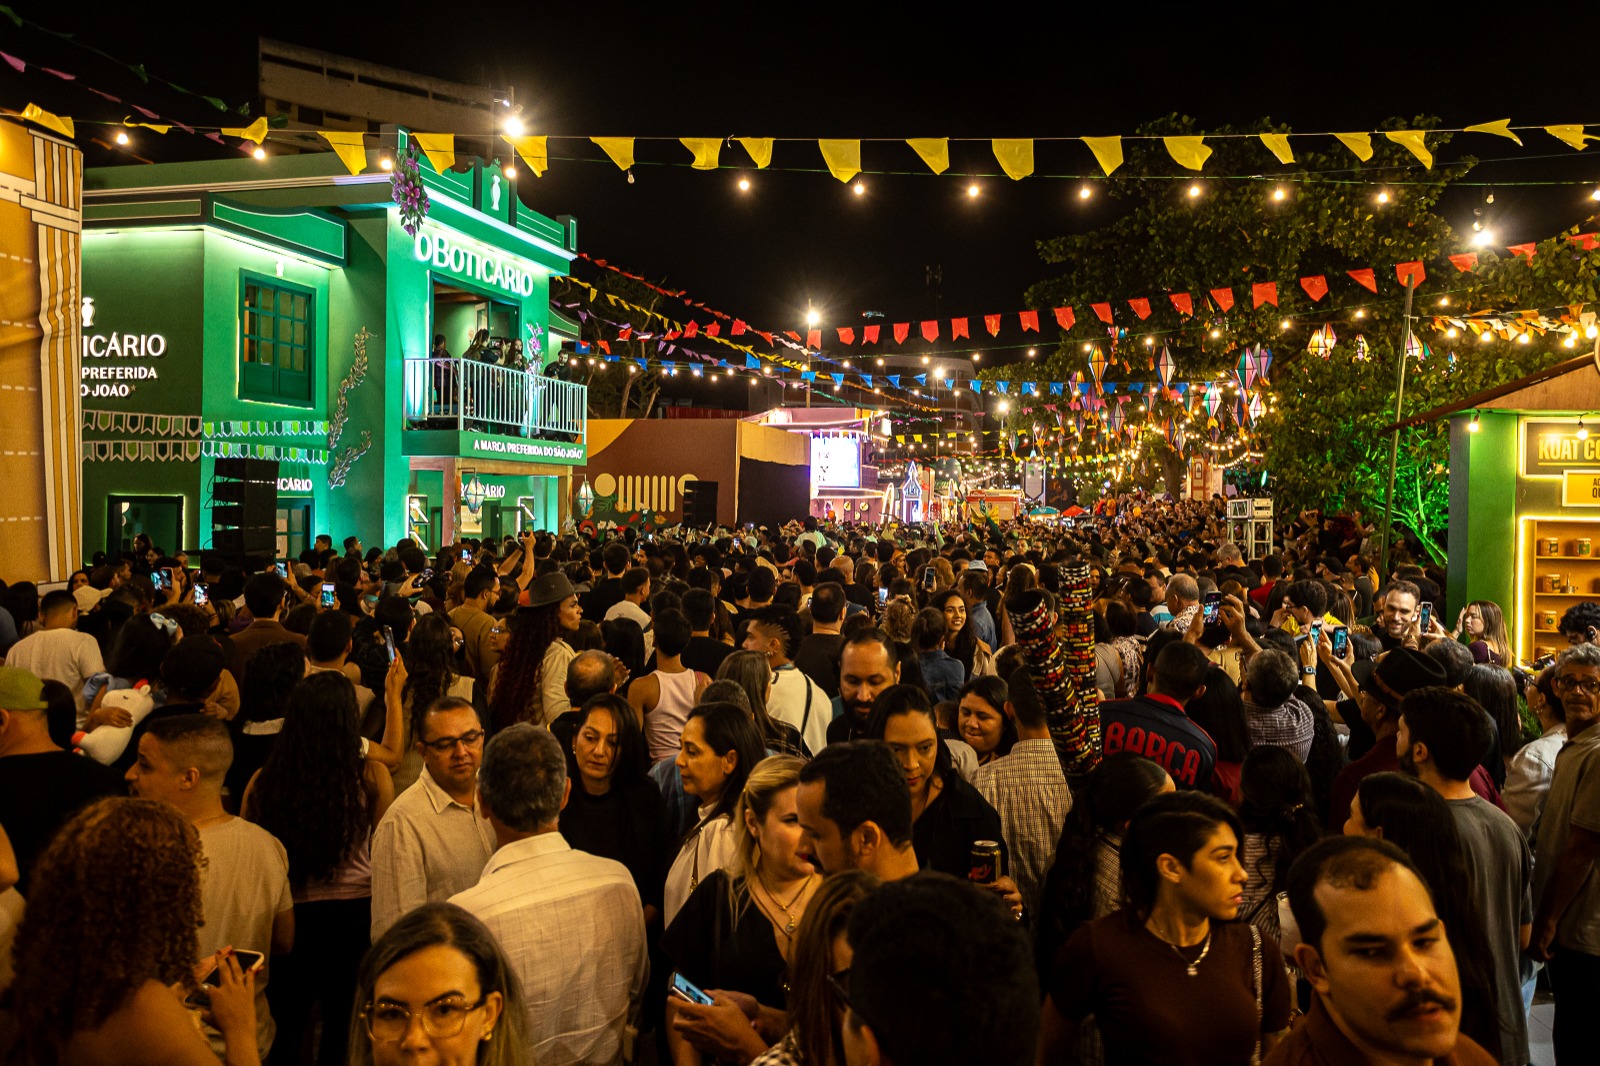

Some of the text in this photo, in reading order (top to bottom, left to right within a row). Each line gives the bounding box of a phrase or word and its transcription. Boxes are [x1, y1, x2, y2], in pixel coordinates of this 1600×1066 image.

[82, 332, 167, 357] ICÁRIO
[82, 367, 158, 379] PREFERIDA
[92, 382, 130, 397] JOÃO
[474, 439, 481, 450] A
[481, 440, 506, 453] MARCA
[507, 443, 543, 456] PREFERIDA
[544, 447, 553, 457] DO
[554, 445, 566, 458] SÃO
[1538, 439, 1580, 460] KUAT
[277, 477, 313, 492] ICÁRIO
